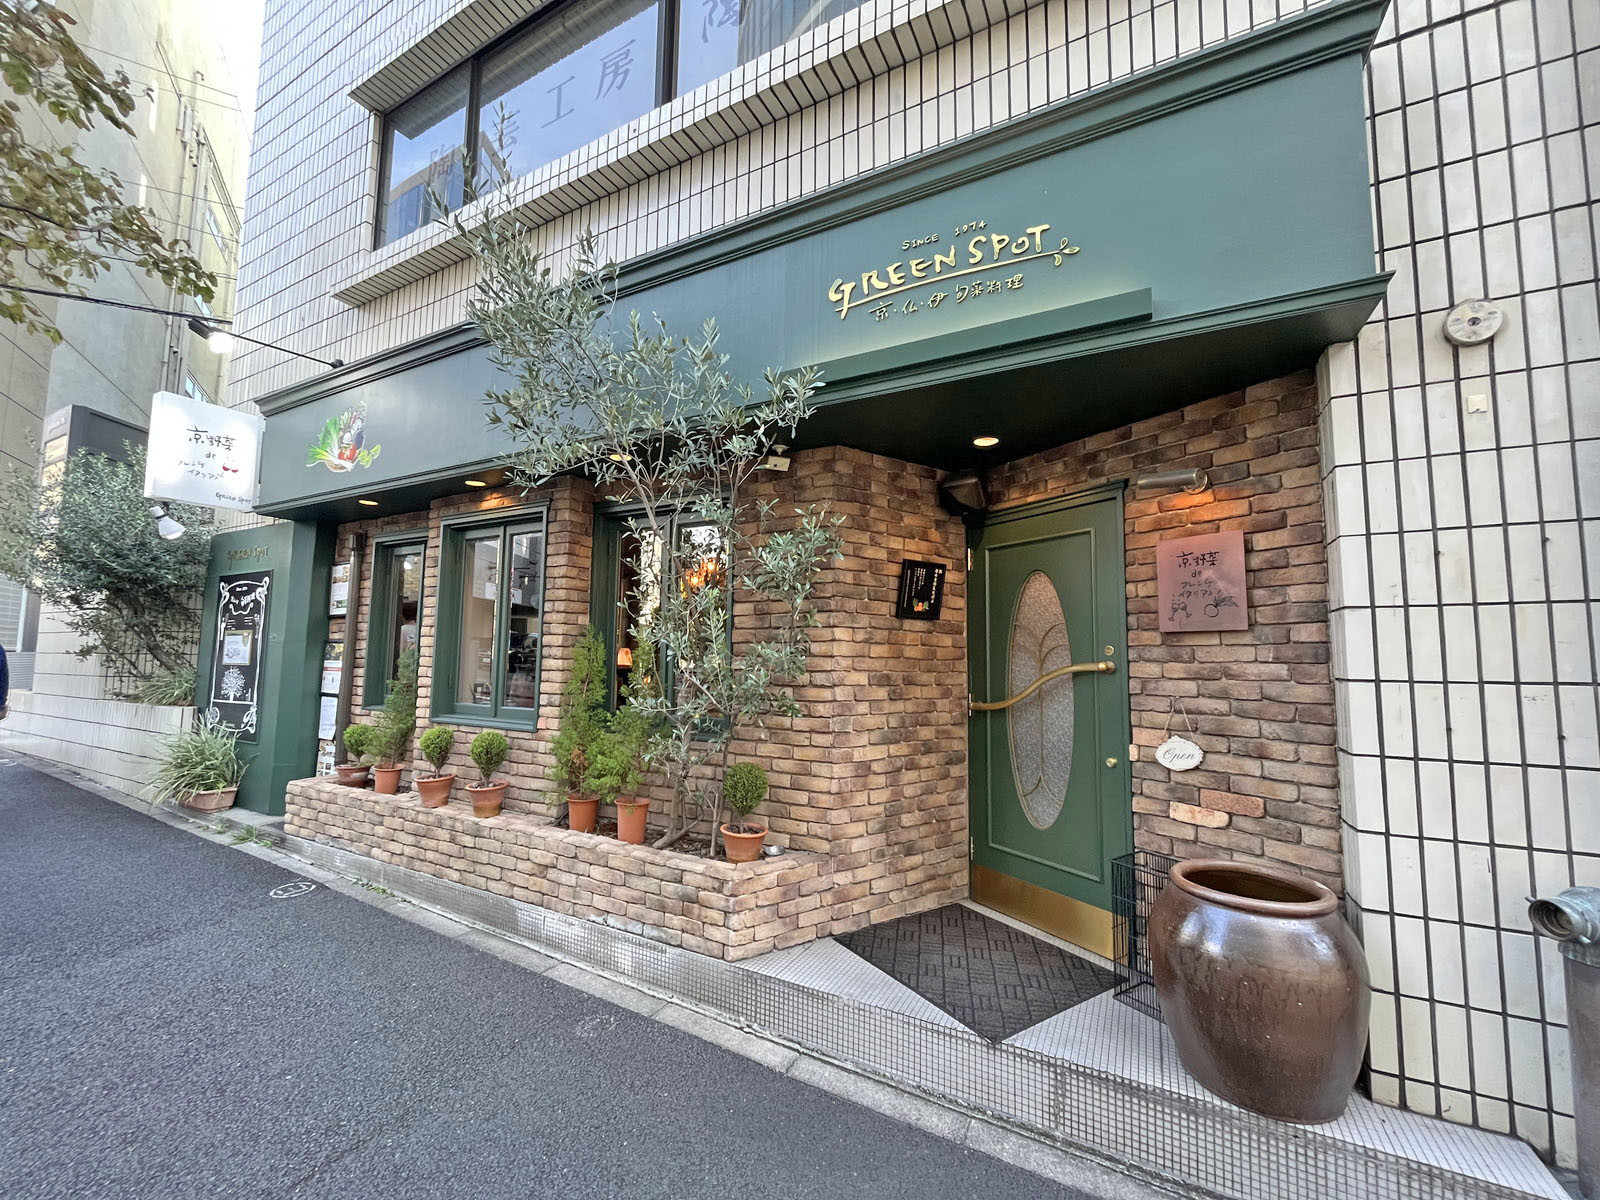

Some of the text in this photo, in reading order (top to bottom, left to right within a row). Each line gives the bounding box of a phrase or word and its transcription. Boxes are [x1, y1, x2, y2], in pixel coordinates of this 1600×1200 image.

[901, 220, 988, 250] SINCE 1974
[828, 223, 1051, 320] GREEN SPOT
[1176, 550, 1220, 568] 京野菜
[1191, 570, 1202, 578] de
[1162, 747, 1196, 763] Open
